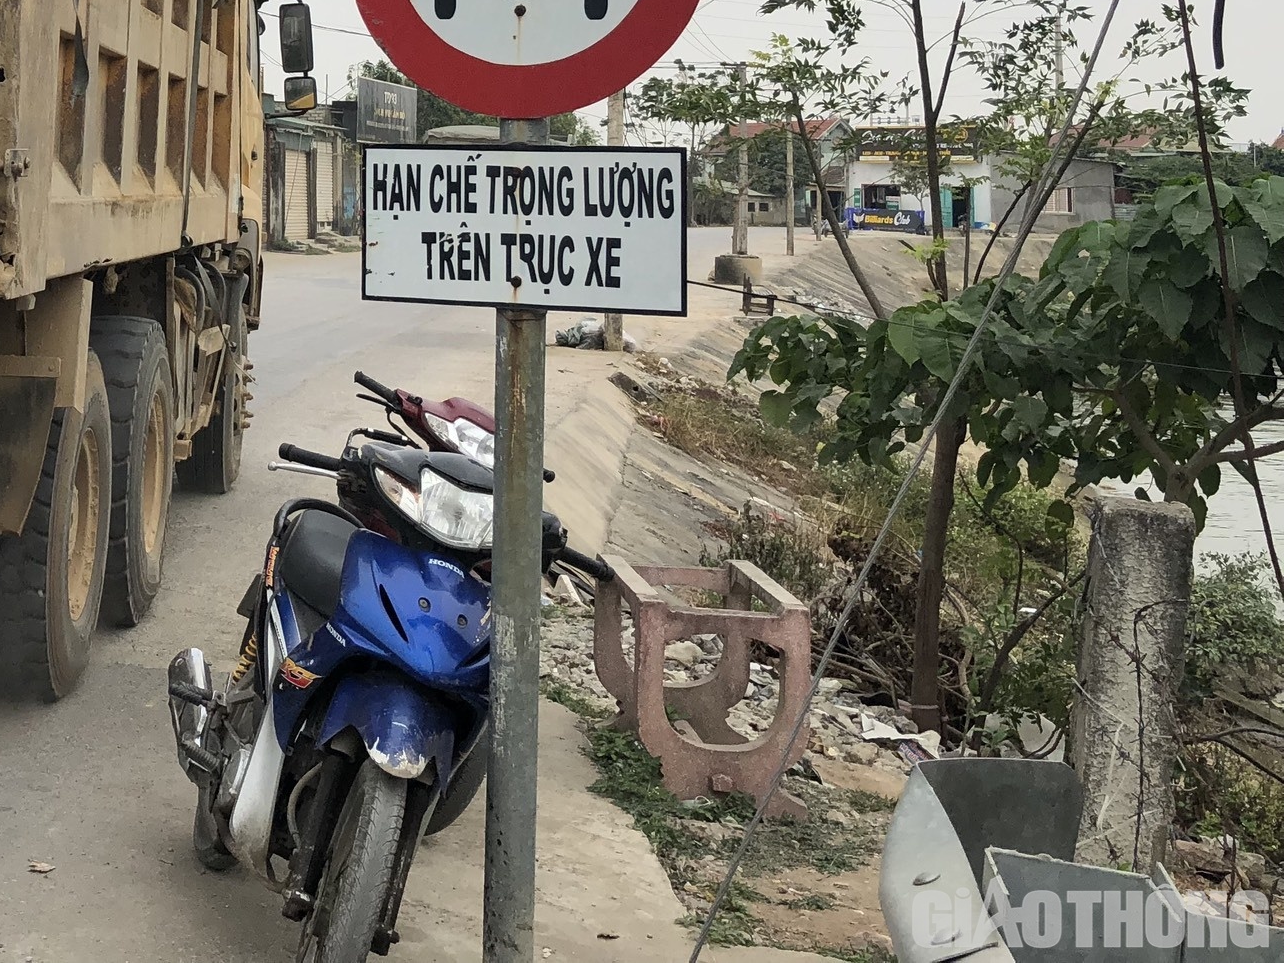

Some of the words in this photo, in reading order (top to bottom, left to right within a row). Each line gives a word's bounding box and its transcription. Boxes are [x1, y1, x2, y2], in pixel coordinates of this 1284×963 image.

[372, 163, 421, 220] HẠN
[429, 154, 483, 214] CHẾ
[486, 164, 575, 225] TRỌNG
[583, 162, 674, 227] LƯỢNG
[421, 222, 491, 282] TRÊN
[500, 233, 575, 295] TRỤC
[584, 236, 622, 288] XE
[428, 558, 465, 579] HONDA
[325, 621, 347, 648] HONDA
